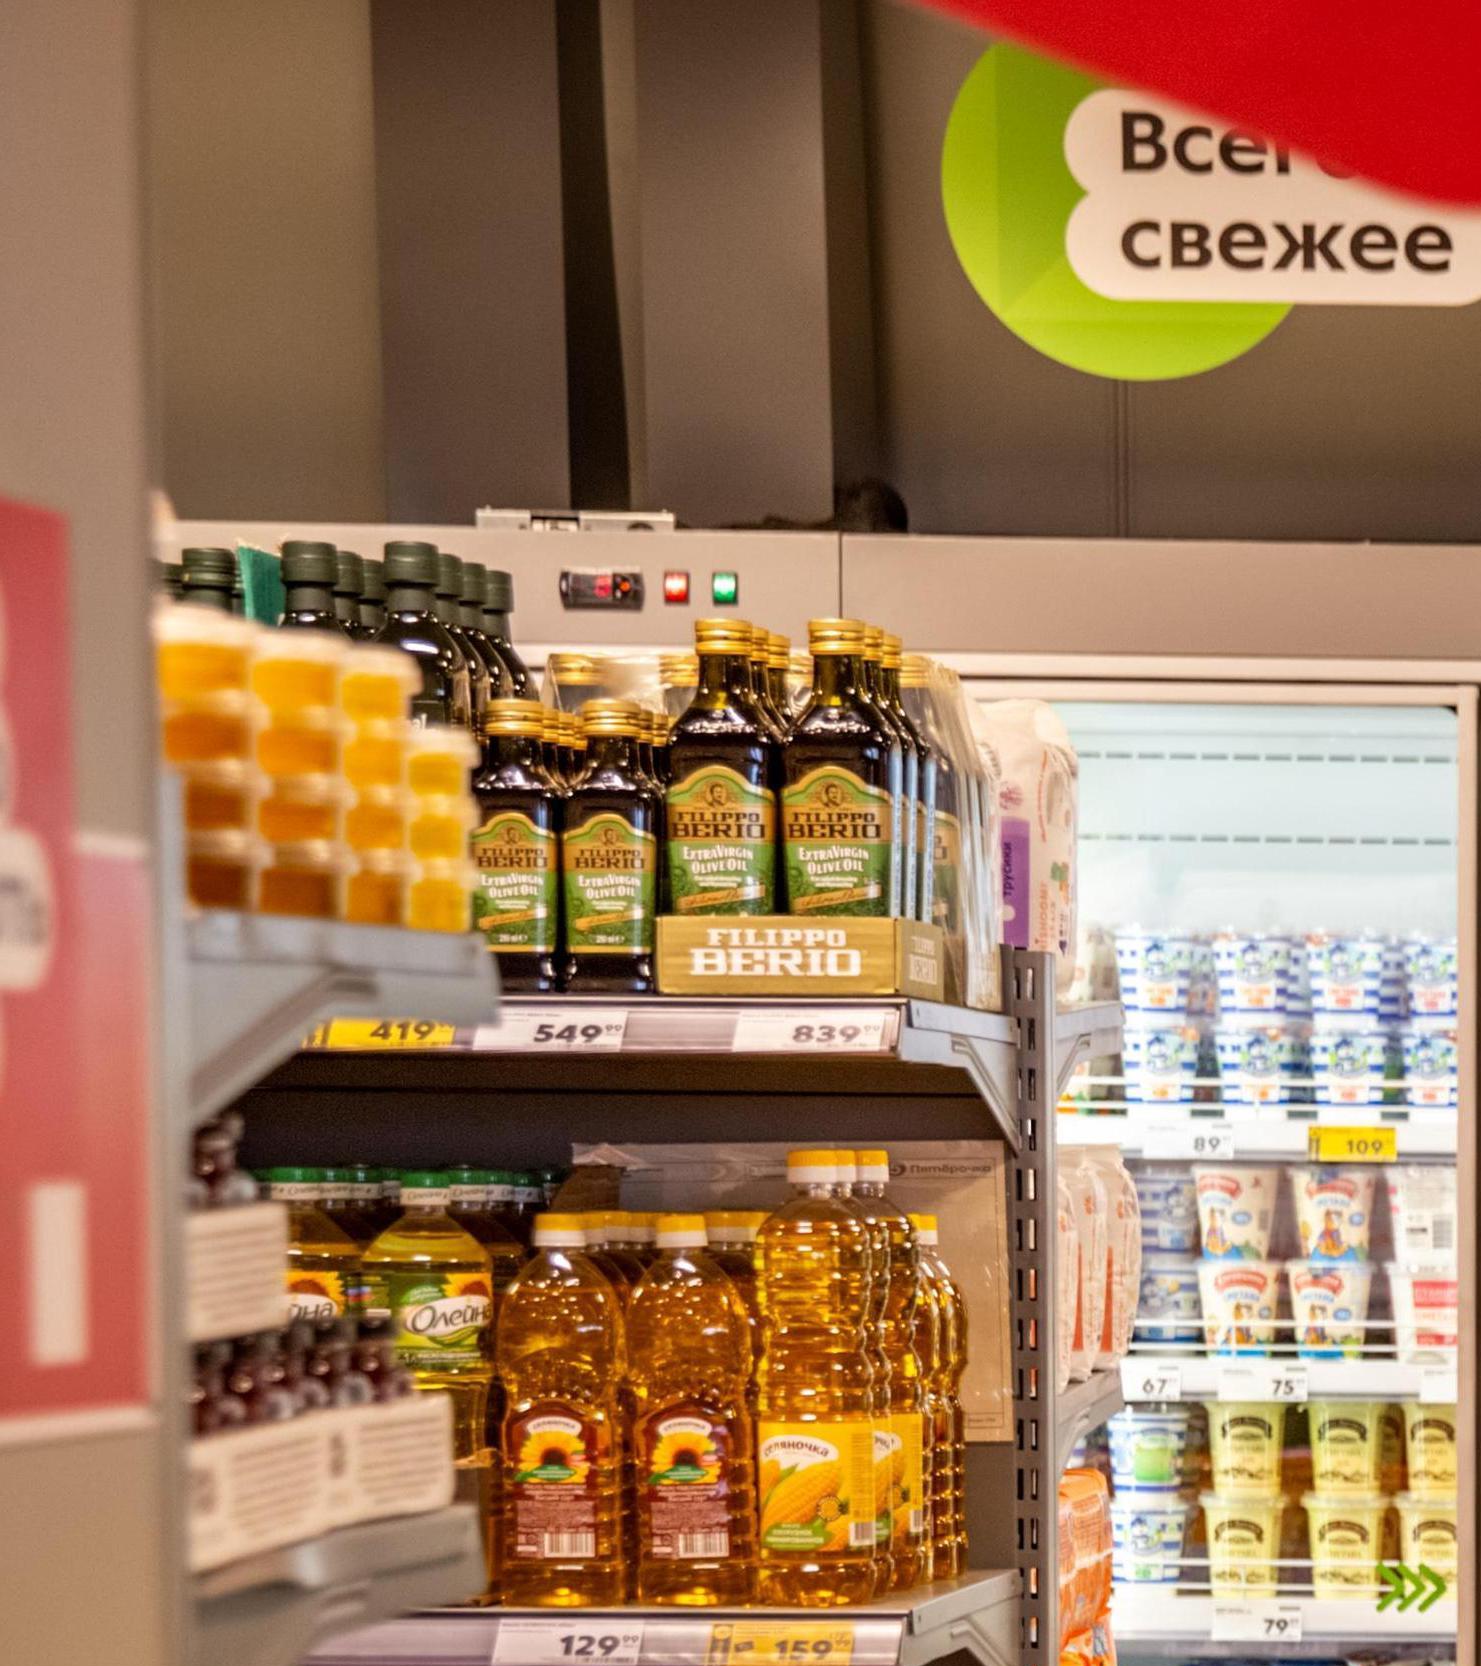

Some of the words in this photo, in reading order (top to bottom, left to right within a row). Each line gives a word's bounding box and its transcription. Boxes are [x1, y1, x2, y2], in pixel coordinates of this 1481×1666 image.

[1121, 110, 1355, 179] Все
[1121, 221, 1454, 272] свежее
[792, 812, 876, 823] FILIPPO
[788, 824, 881, 839] BERIO
[580, 849, 641, 857] FILIPPO
[575, 857, 645, 869] BERIO
[707, 928, 846, 947] FILIPPO
[690, 949, 862, 977] BERIO
[370, 1021, 435, 1040] 419
[532, 1024, 599, 1043] 549
[791, 1025, 860, 1043] 839
[1194, 1136, 1221, 1151] 89
[1346, 1139, 1383, 1154] 109
[1142, 1378, 1168, 1394] 67
[1272, 1379, 1294, 1394] 75
[1263, 1619, 1289, 1634] 79
[560, 1635, 619, 1657] 129
[773, 1640, 832, 1661] 159
